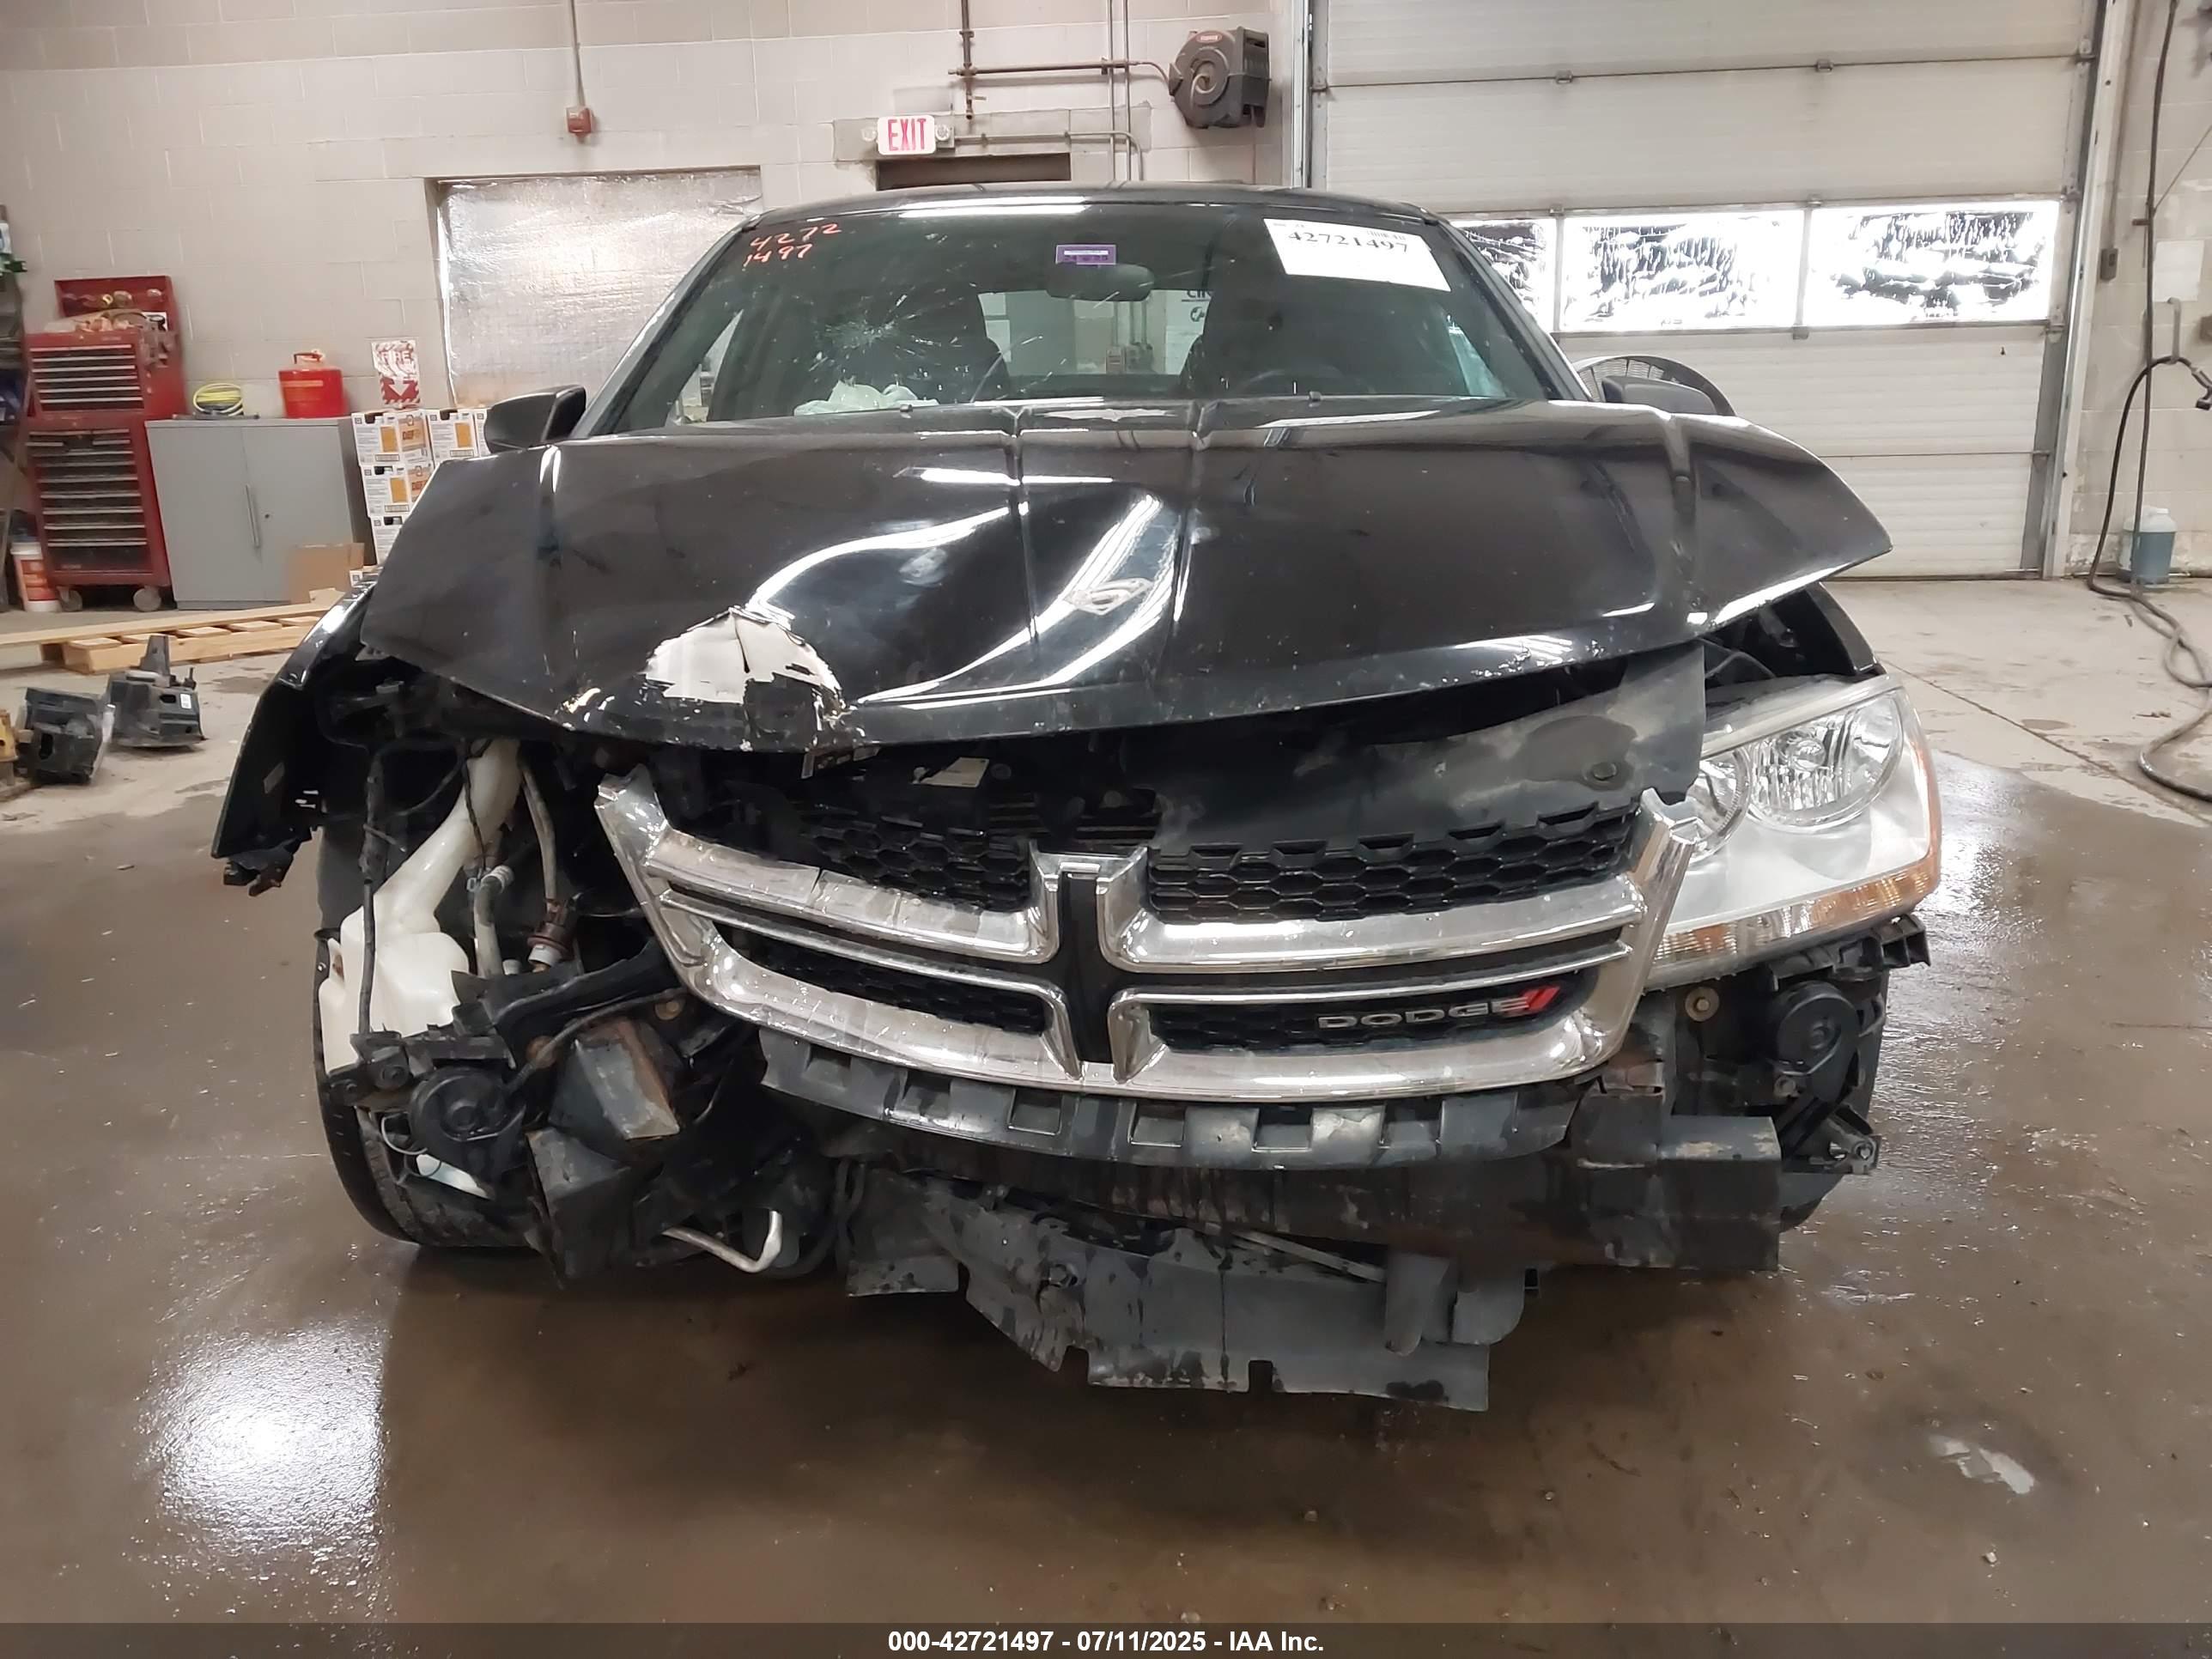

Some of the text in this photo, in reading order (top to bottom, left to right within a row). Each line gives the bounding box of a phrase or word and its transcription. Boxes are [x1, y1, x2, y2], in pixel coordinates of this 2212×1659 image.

[887, 118, 927, 151] EXIT
[750, 222, 842, 251] 4272
[1288, 231, 1407, 252] 42721497
[743, 244, 813, 267] 1497
[1317, 996, 1529, 1029] DODGE
